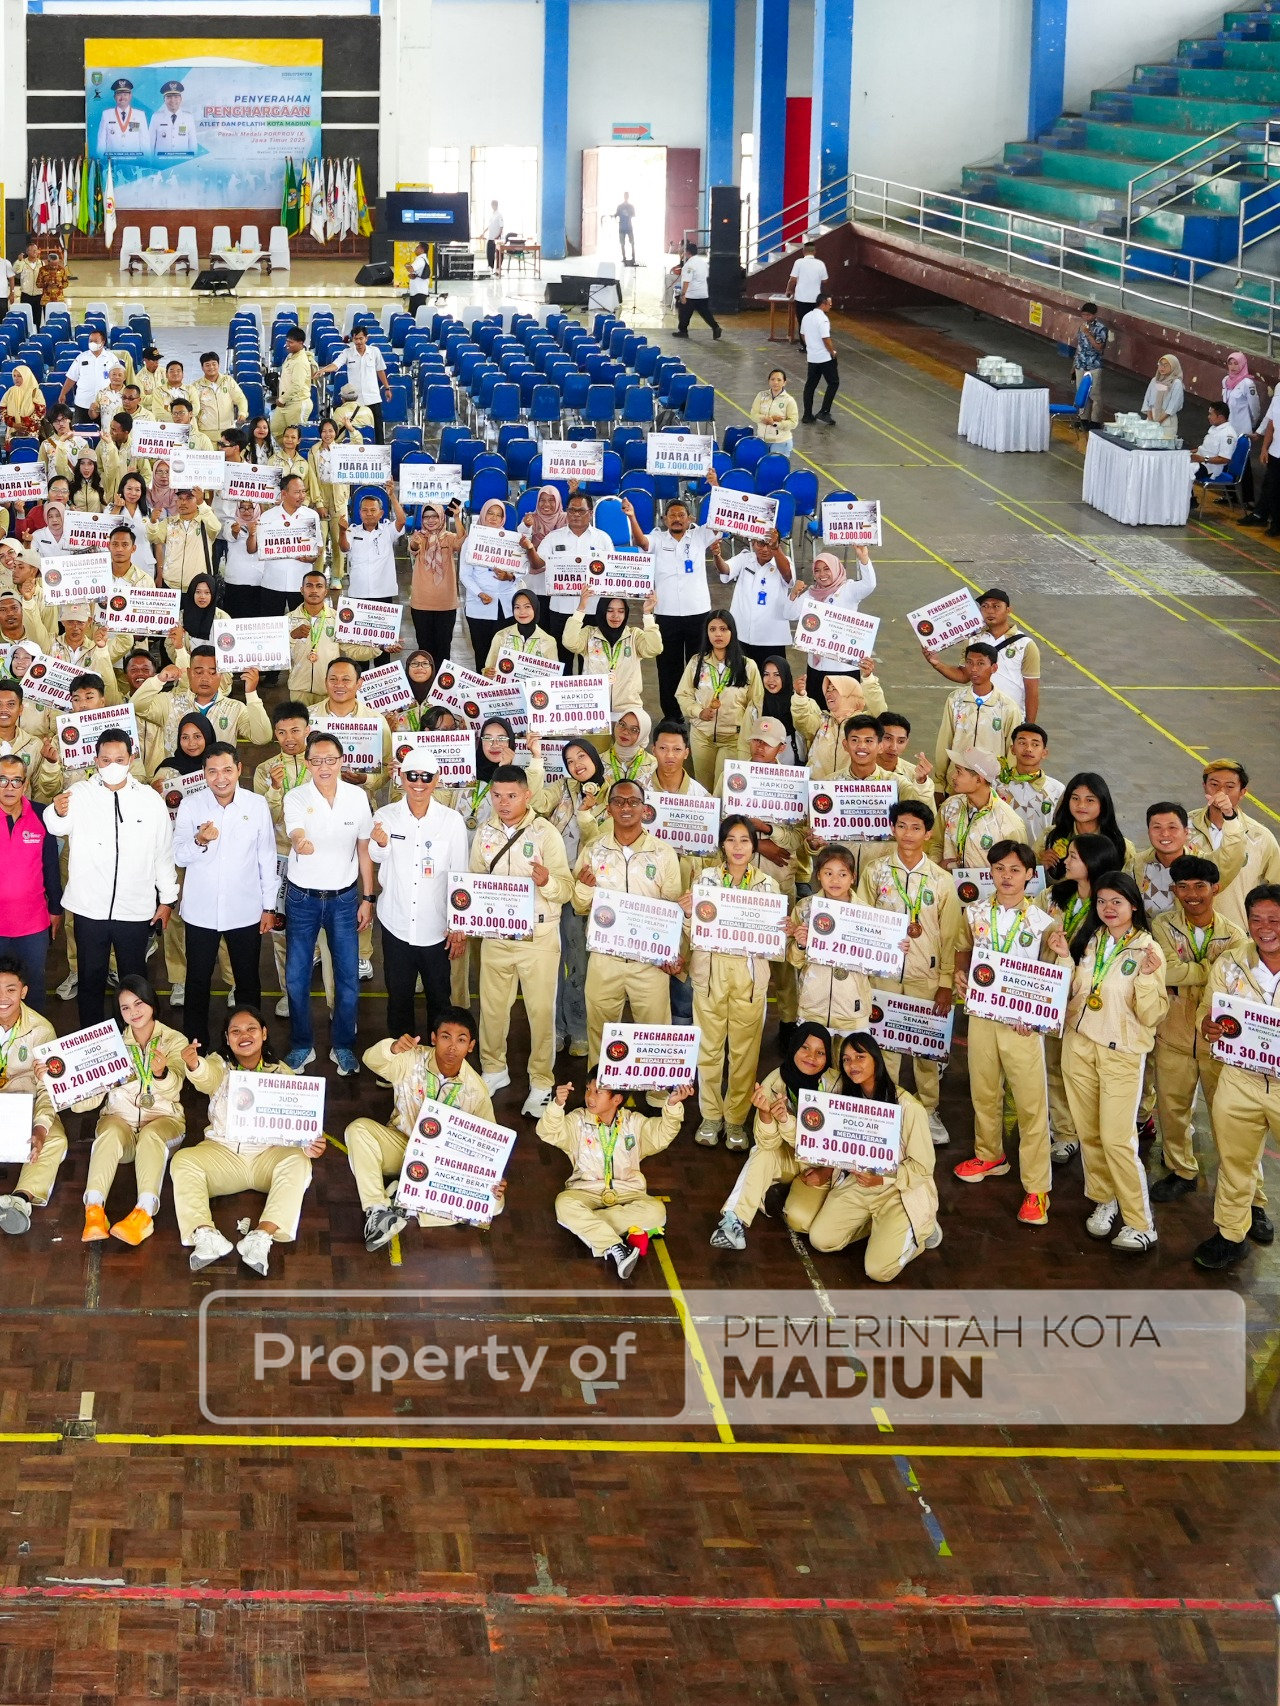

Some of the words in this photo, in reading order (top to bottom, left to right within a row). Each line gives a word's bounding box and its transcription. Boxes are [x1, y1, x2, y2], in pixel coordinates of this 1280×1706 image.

[235, 95, 310, 103] PENYERAHAN
[204, 106, 310, 118] PENGHARGAAN
[139, 438, 163, 446] JUARA
[166, 439, 174, 447] IV
[656, 452, 689, 461] JUARA
[694, 453, 702, 462] II
[580, 459, 587, 467] IV
[230, 480, 256, 489] JUARA
[259, 481, 266, 490] IV
[8, 489, 41, 497] 2.000.000
[240, 490, 274, 499] 2.000.000
[716, 508, 745, 520] JUARA
[748, 513, 756, 523] IV
[715, 517, 726, 526] Rp.
[727, 520, 765, 534] 2.000.000
[829, 522, 853, 530] JUARA
[856, 522, 863, 530] IV
[70, 530, 96, 538] JUARA
[830, 532, 839, 540] Rp.
[265, 538, 290, 546] JUARA
[277, 545, 310, 553] 2.000.000
[474, 544, 502, 555] JUARA
[62, 558, 107, 567] PENGHARGAAN
[473, 553, 484, 561] Rp.
[485, 555, 520, 567] 2.000.000
[607, 554, 651, 563] PENGHARGAAN
[554, 574, 582, 582] JUARA
[760, 781, 794, 789] HAPKIDO
[834, 784, 892, 793] PENGHARGAAN
[670, 812, 704, 821] HAPKIDO
[453, 914, 468, 926] Rp.
[470, 915, 527, 930] 30.000.000
[695, 925, 713, 939] Rp.
[717, 927, 780, 946] 10.000.000
[855, 924, 882, 936] SENAM
[811, 937, 829, 952] Rp.
[832, 941, 898, 965] 20.000.000
[1000, 958, 1063, 980] PENGHARGAAN
[1003, 976, 1054, 992] BARONGSAI
[1006, 988, 1028, 998] MEDALI
[1030, 993, 1047, 1002] EMAS
[970, 989, 987, 1003] Rp.
[991, 994, 1059, 1020] 50.000.000
[903, 1016, 928, 1025] SENAM
[633, 1031, 695, 1042] PENGHARGAAN
[883, 1028, 944, 1050] 10.000.000
[637, 1047, 687, 1055] BARONGSAI
[53, 1081, 70, 1095] Rp.
[70, 1057, 128, 1088] 20.000.000
[604, 1064, 622, 1076] Rp.
[625, 1065, 691, 1078] 40.000.000
[829, 1100, 895, 1118] PENGHARGAAN
[253, 1116, 317, 1132] 10.000.000
[843, 1119, 864, 1127] POLO
[866, 1122, 879, 1130] AIR
[837, 1131, 861, 1140] MEDALI
[862, 1135, 884, 1143] PERAK
[801, 1134, 818, 1148] Rp.
[823, 1138, 893, 1161] 30.000.000
[434, 1156, 497, 1178] PENGHARGAAN
[430, 1181, 454, 1194] MEDALI
[456, 1186, 489, 1200] PERUNGGU
[403, 1183, 421, 1199] Rp.
[425, 1189, 489, 1215] 10.000.000
